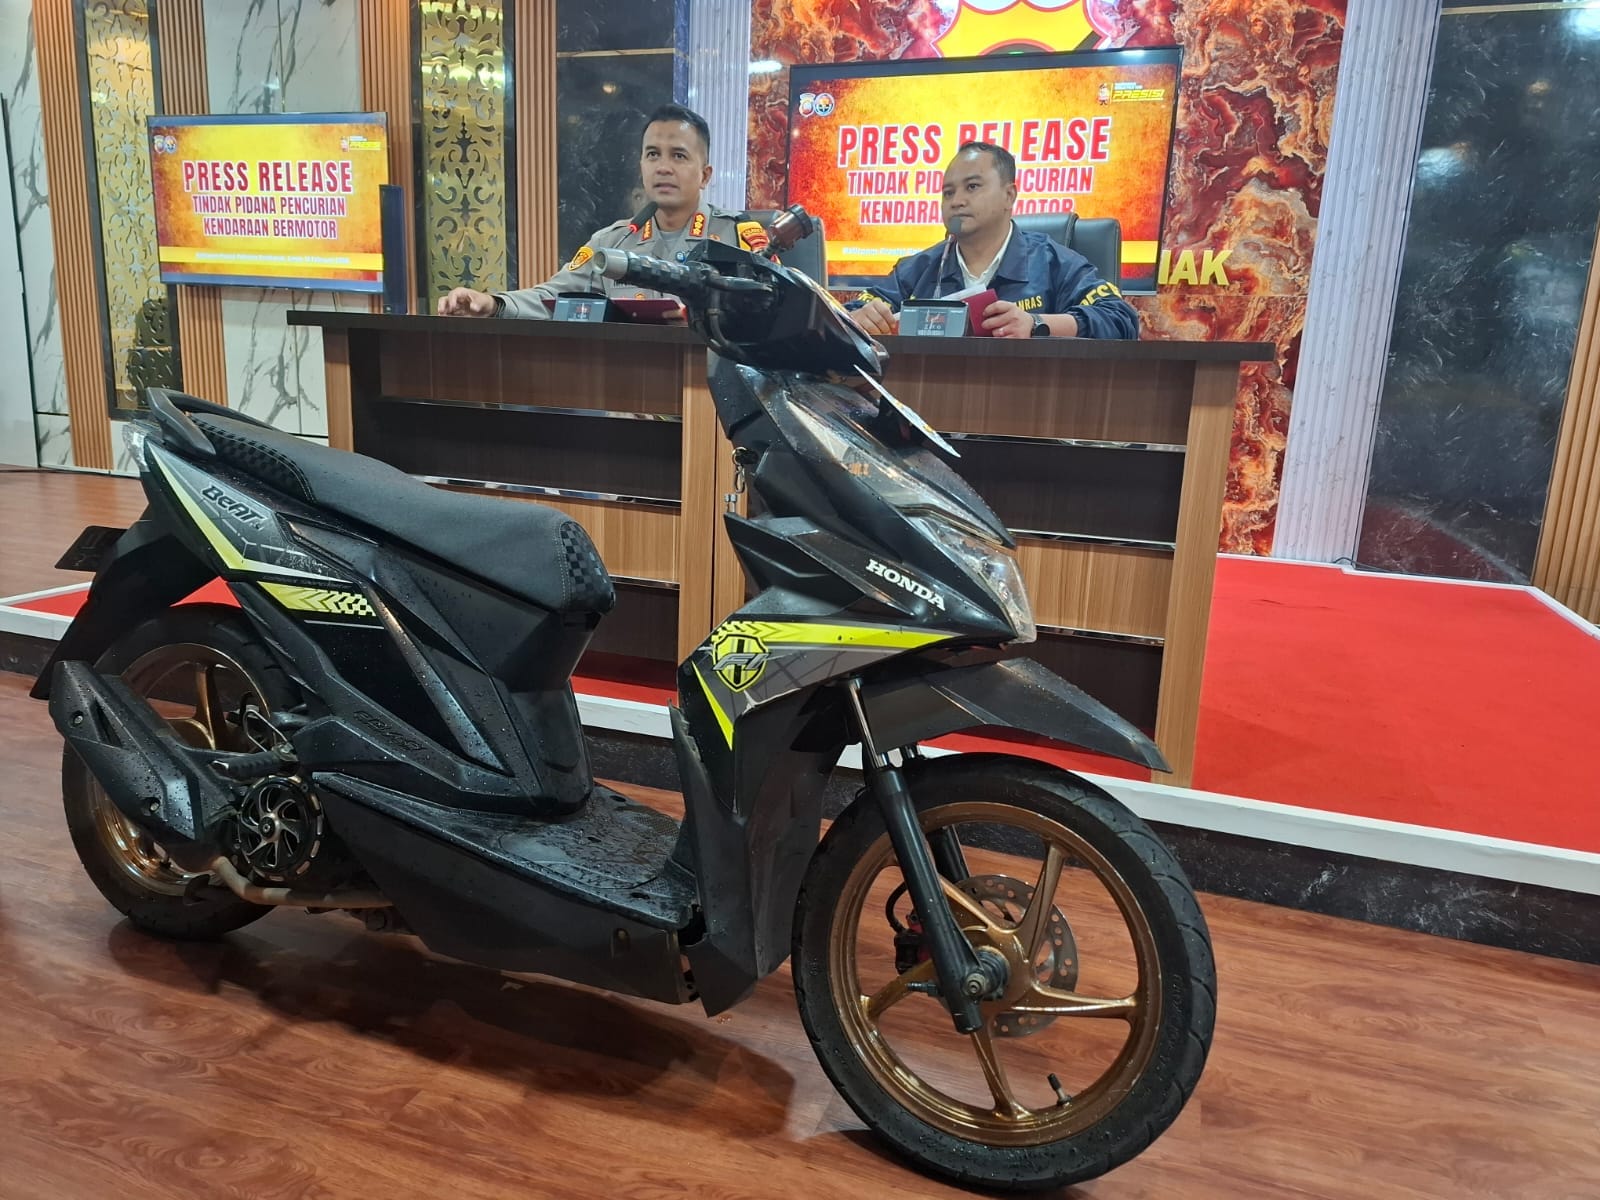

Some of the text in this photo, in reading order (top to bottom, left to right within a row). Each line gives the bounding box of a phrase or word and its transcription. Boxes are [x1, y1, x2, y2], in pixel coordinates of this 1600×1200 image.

[838, 124, 942, 165] PRESS
[184, 161, 352, 193] PRESS RELEASE
[848, 171, 909, 195] TINDAK
[914, 170, 944, 194] PID
[192, 195, 345, 216] TINDAK PIDANA PENCURIAN
[860, 200, 944, 224] KENDARA
[203, 218, 337, 238] KENDARAAN BERMOTOR
[1158, 249, 1233, 285] IAK
[865, 558, 946, 611] HONDA
